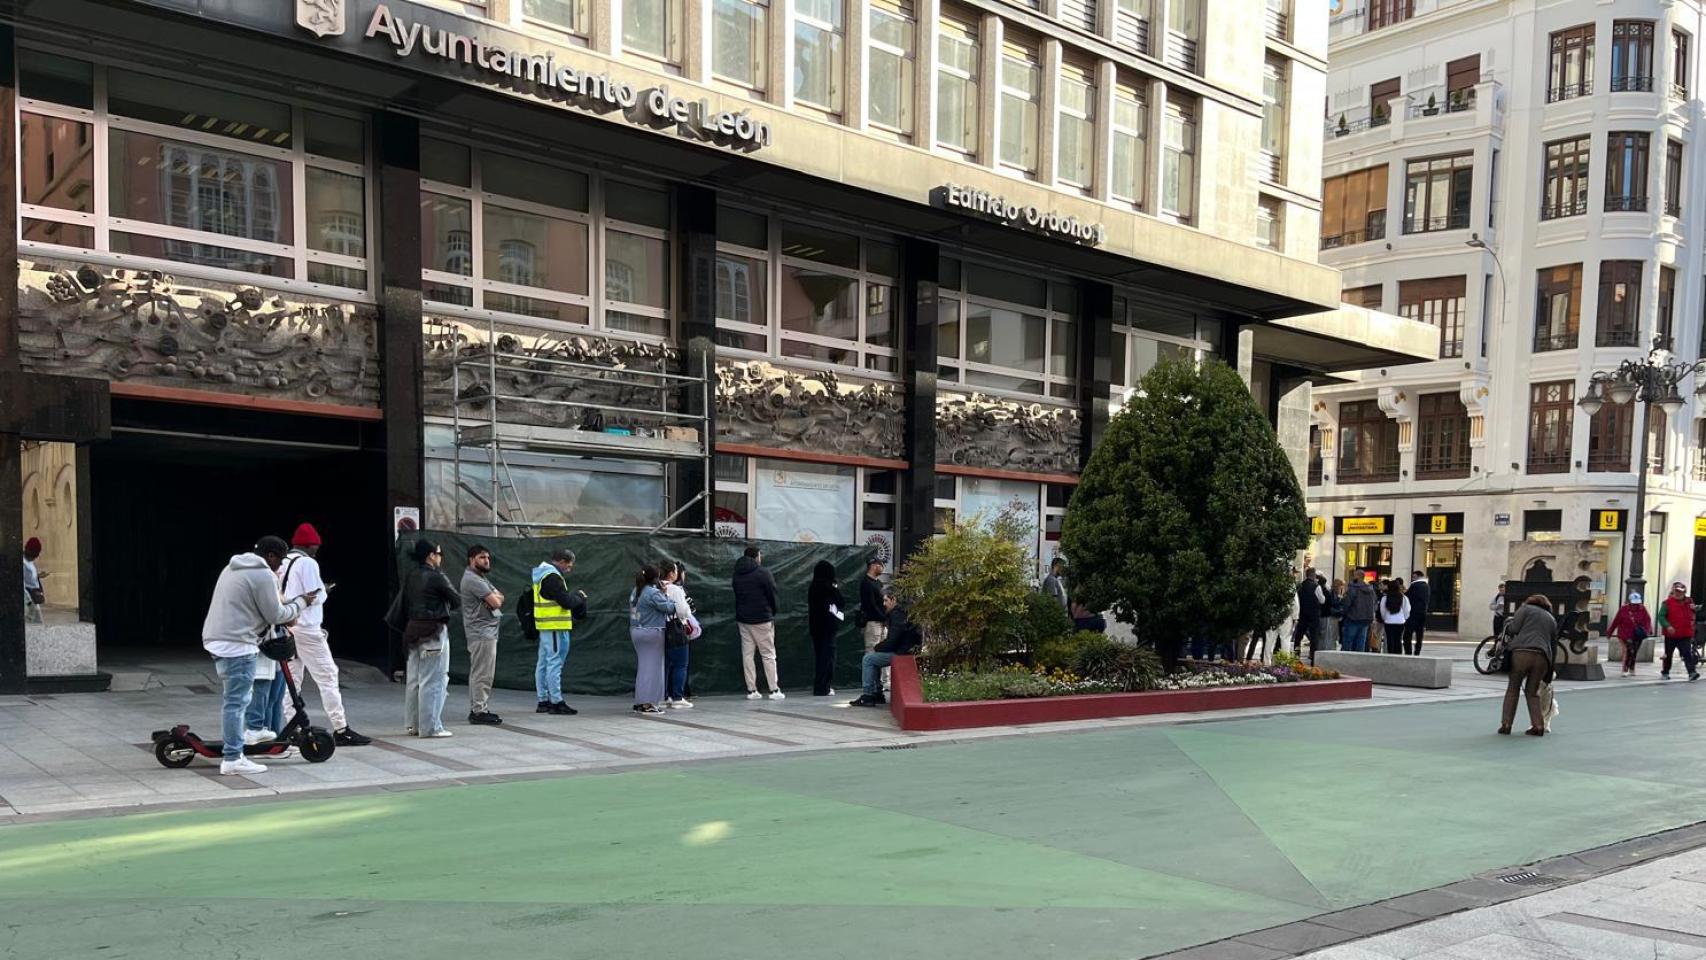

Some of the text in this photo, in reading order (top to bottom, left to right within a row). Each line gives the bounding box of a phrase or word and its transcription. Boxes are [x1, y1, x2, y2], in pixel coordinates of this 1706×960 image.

[365, 4, 771, 146] Ayuntamiento de León
[947, 183, 1019, 220] Edificio
